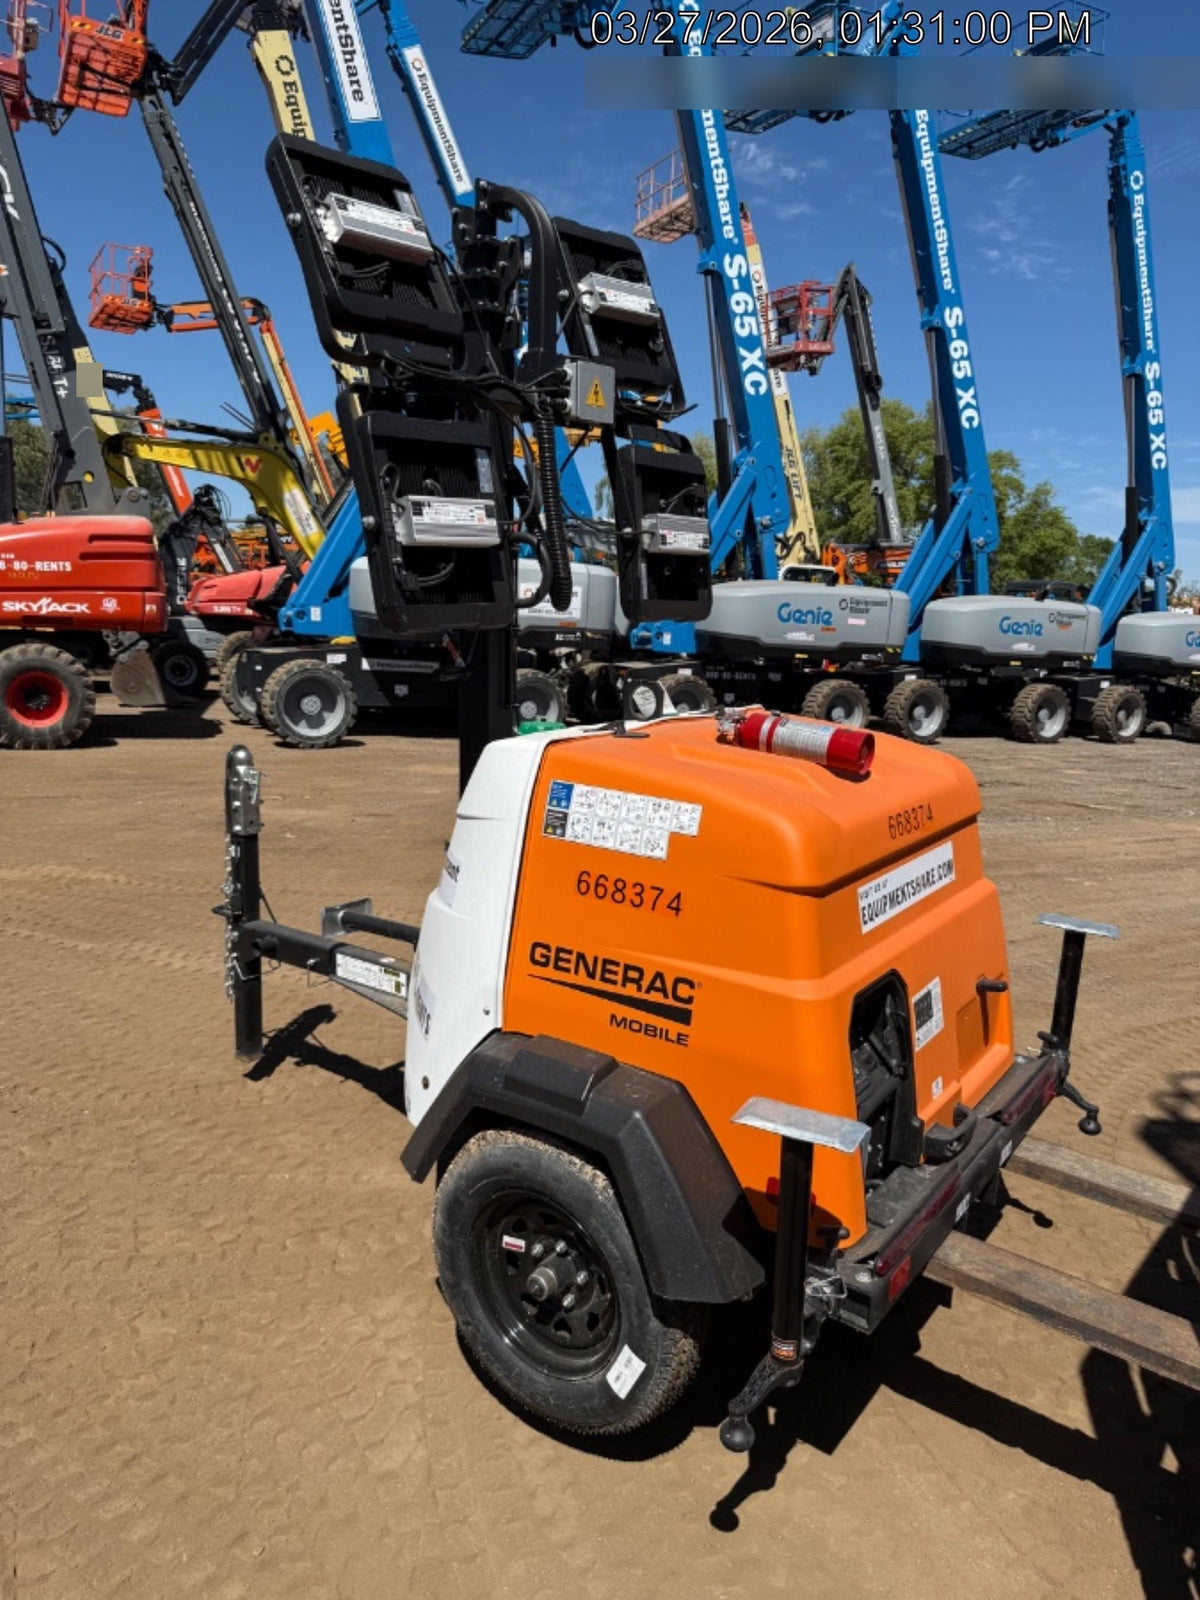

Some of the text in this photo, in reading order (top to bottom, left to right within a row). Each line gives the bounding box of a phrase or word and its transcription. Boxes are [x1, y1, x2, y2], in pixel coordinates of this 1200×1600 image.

[417, 72, 463, 183] EquipmentShare
[1132, 193, 1155, 352] EquipmentShare
[723, 252, 768, 396] S-65 XC
[943, 306, 980, 430] S-65 XC
[1145, 361, 1168, 471] S-65 XC
[2, 597, 92, 614] SKYJACK
[777, 602, 833, 626] Genie
[999, 615, 1043, 636] Genie
[888, 803, 934, 840] 668374
[576, 870, 682, 917] 668374
[861, 858, 954, 926] EQUIPMENTSHARE.COM
[529, 941, 696, 1005] GENERAC
[609, 1013, 689, 1047] MOBILE
